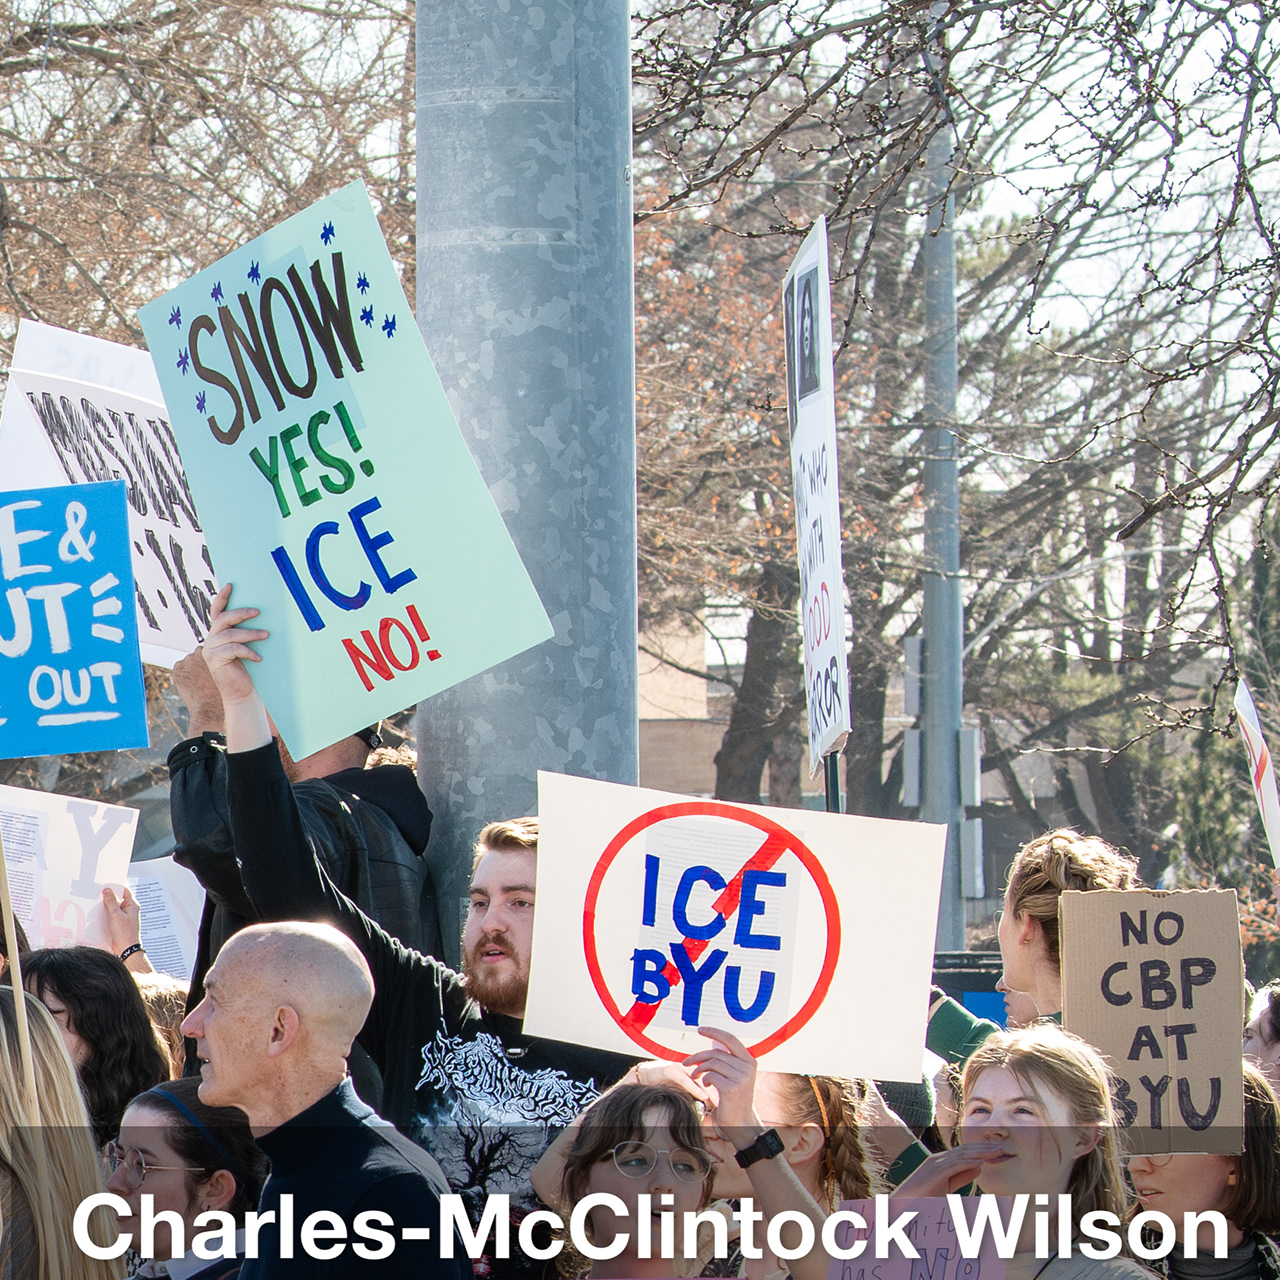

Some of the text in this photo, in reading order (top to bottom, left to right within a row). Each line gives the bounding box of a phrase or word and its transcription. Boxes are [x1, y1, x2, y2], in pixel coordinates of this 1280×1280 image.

[187, 251, 365, 445] SNOW
[248, 400, 376, 518] YES!
[58, 501, 96, 563] &
[270, 495, 418, 633] ICE
[341, 604, 442, 693] NO!
[28, 661, 123, 711] OUT
[642, 854, 787, 951] ICE
[1121, 910, 1185, 947] NO
[630, 942, 776, 1026] BYU
[1100, 957, 1218, 1010] CBP
[1126, 1023, 1197, 1062] AT
[1114, 1075, 1224, 1133] BYU
